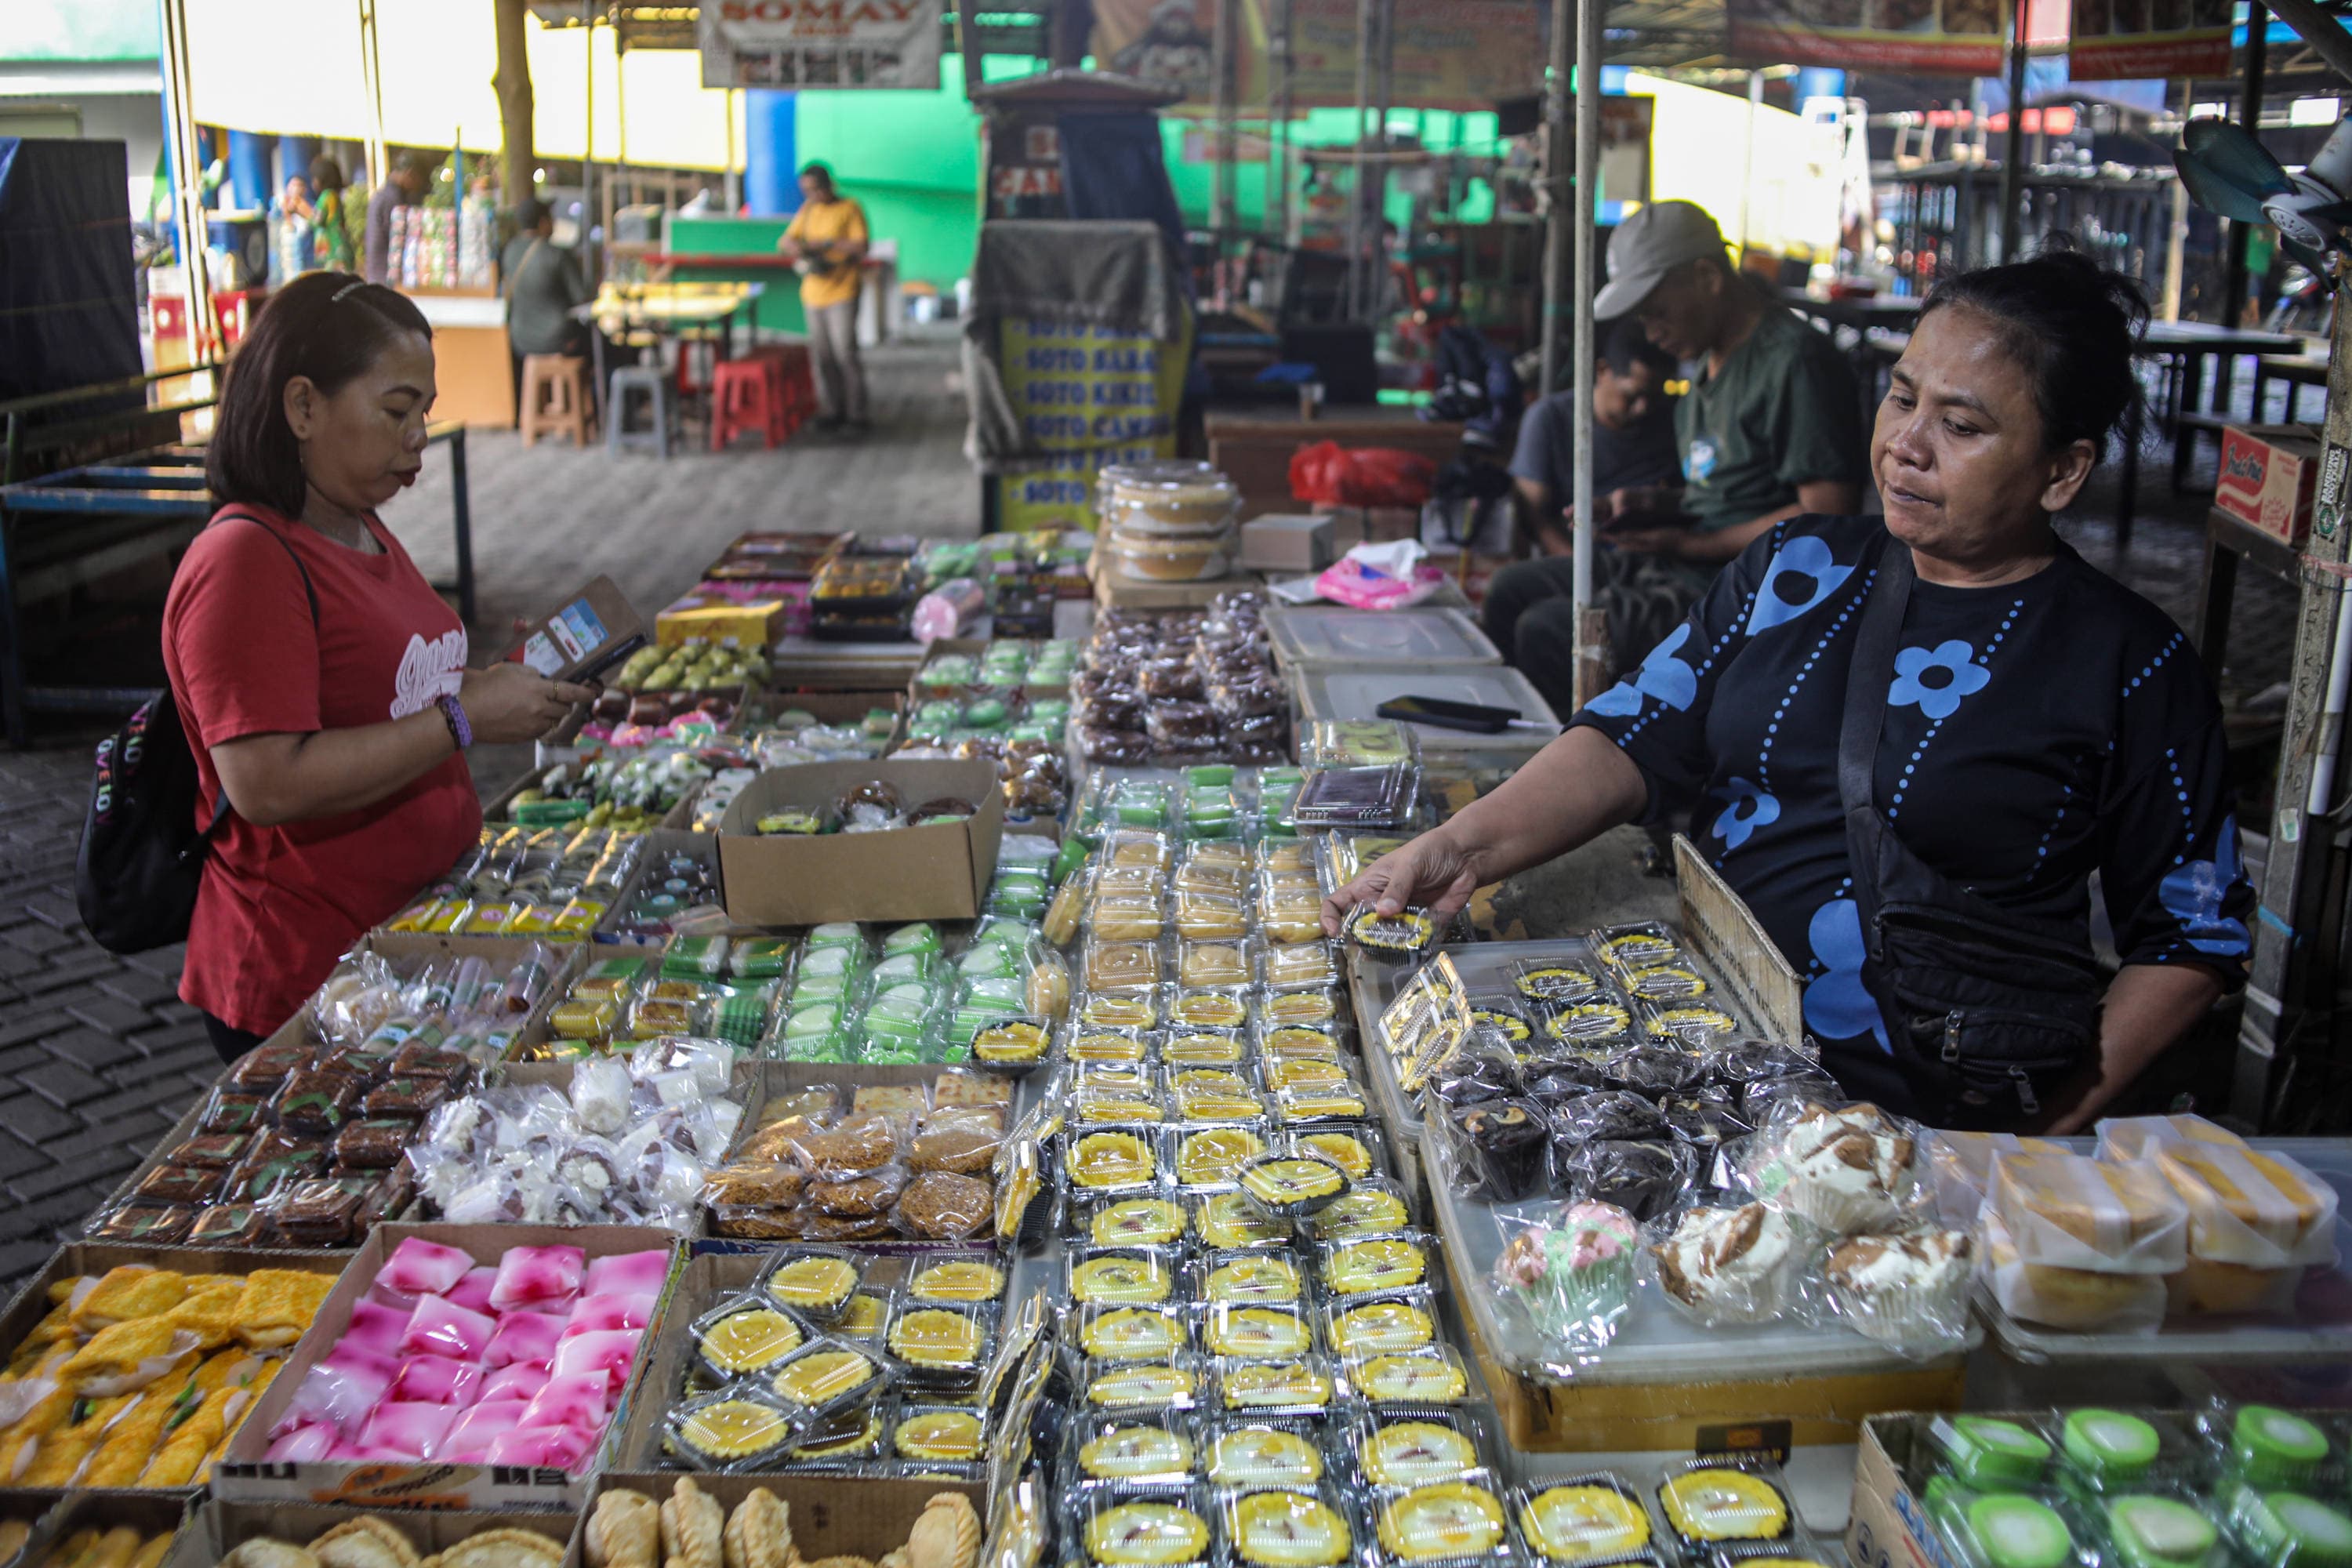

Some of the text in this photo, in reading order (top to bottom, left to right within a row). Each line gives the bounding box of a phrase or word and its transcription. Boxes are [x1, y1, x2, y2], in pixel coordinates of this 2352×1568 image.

[1026, 348, 1087, 372] SOTO
[1026, 382, 1087, 405] SOTO
[1025, 415, 1087, 437] SOTO
[1024, 480, 1087, 504] SOTO
